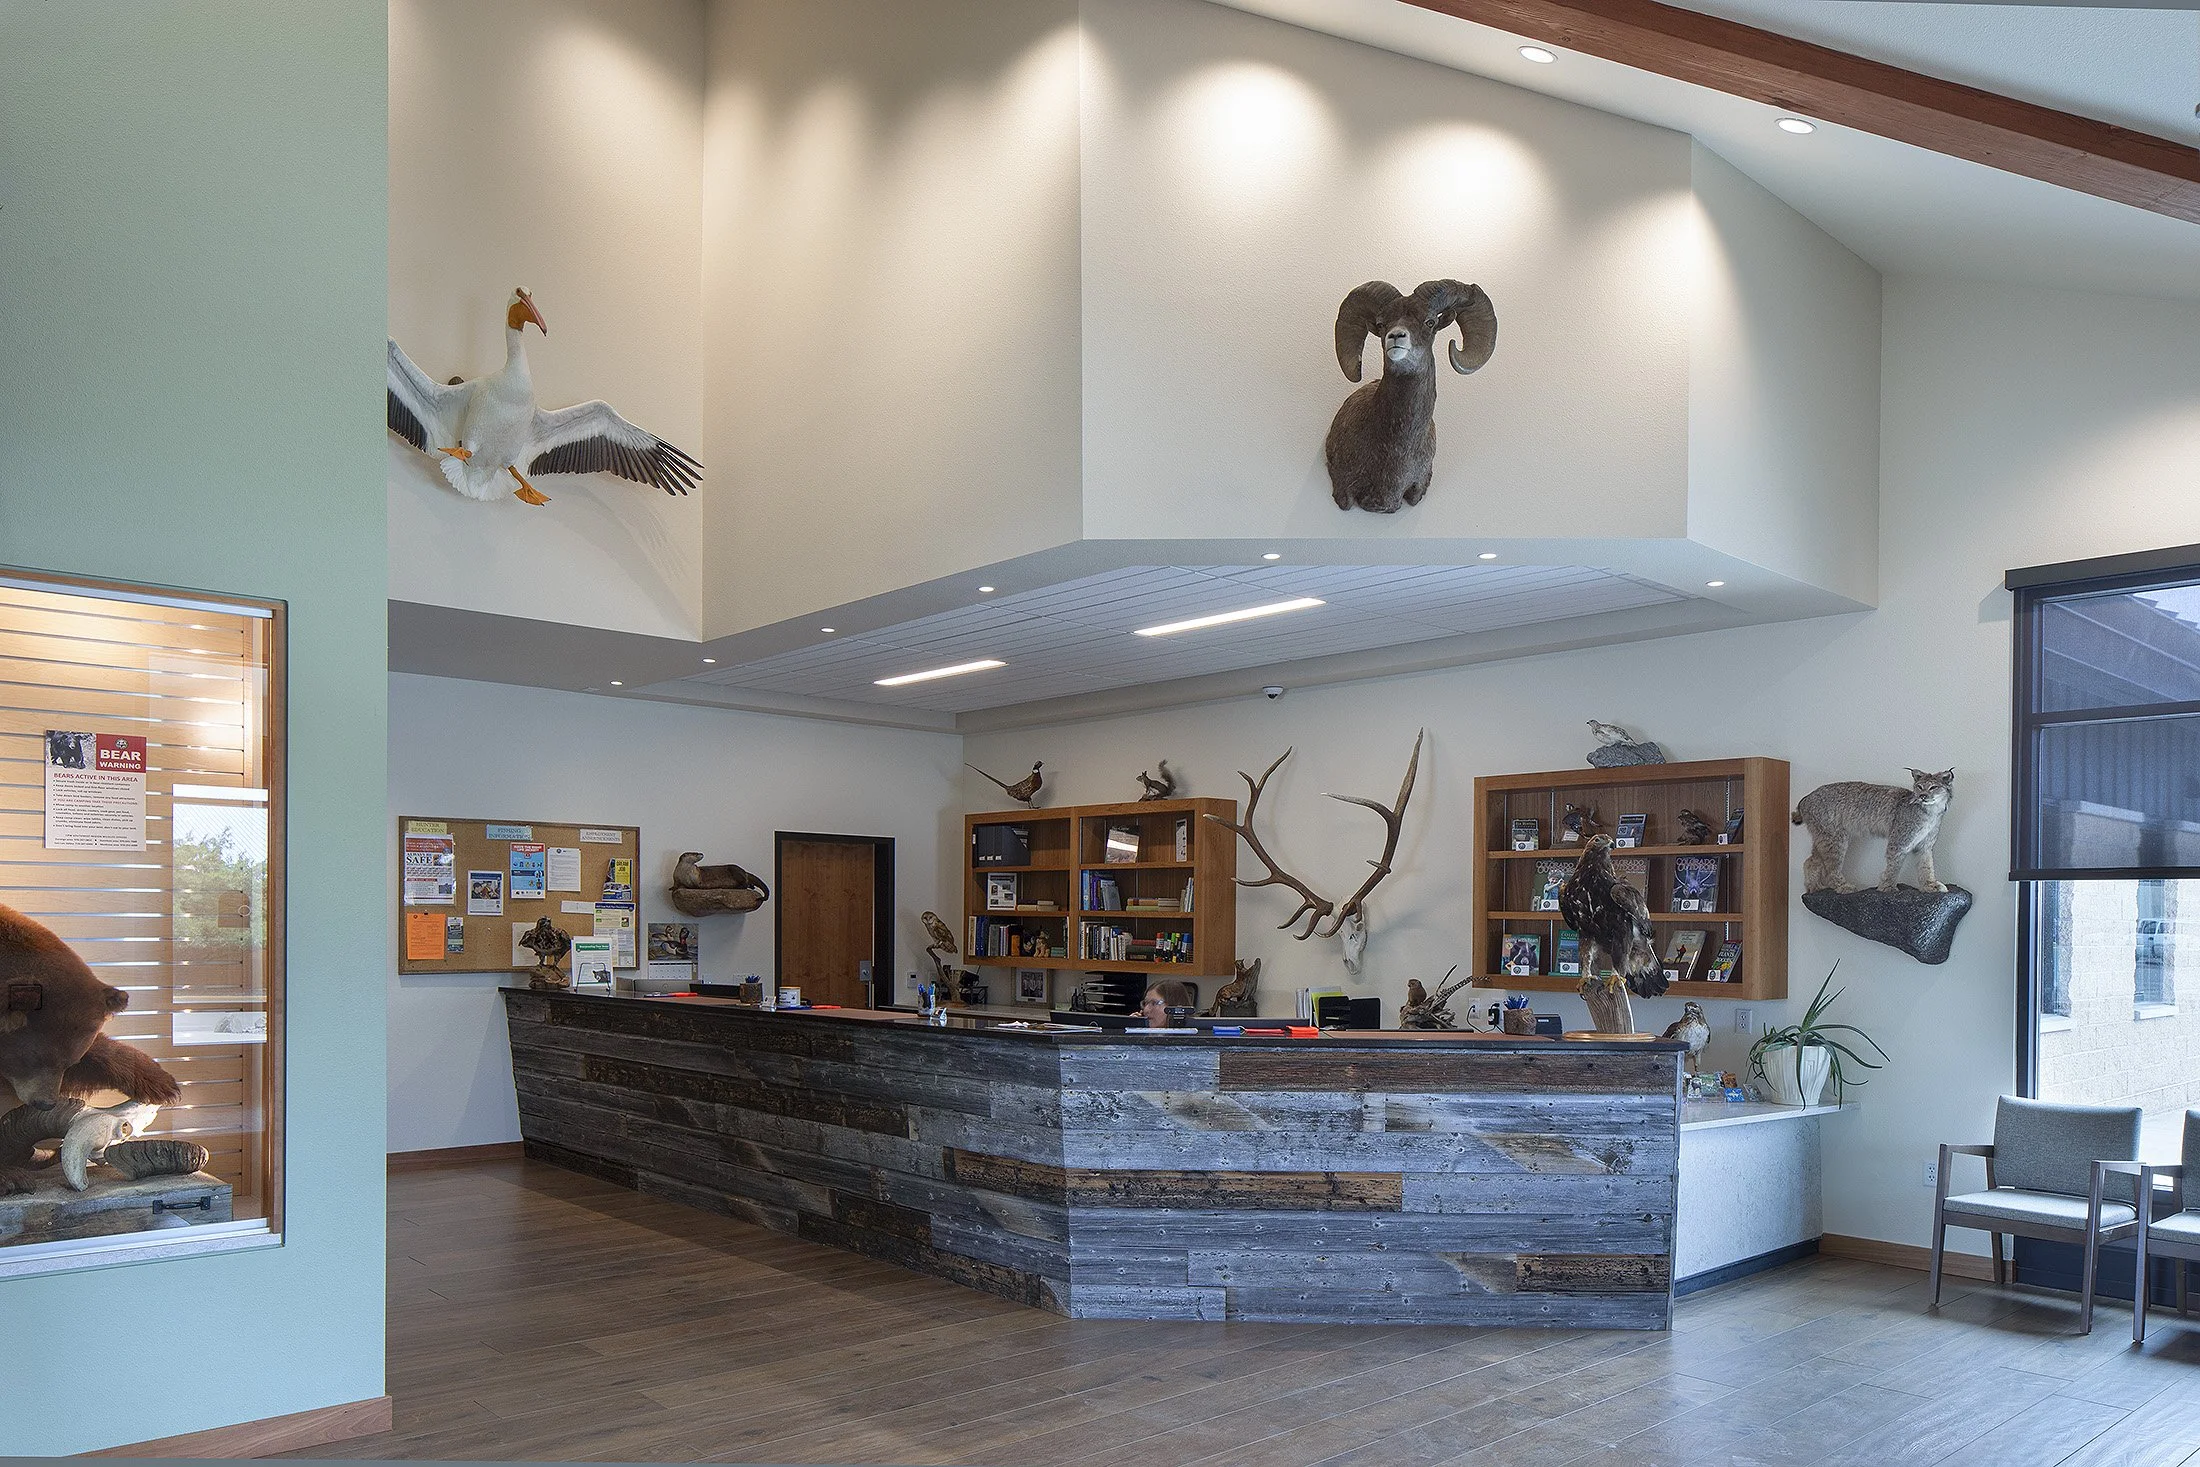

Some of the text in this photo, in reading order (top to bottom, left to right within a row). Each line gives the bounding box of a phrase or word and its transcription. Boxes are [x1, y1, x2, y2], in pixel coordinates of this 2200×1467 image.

[100, 749, 141, 760] BEAR
[100, 761, 141, 769] WARNING
[1536, 860, 1574, 868] COLORADO
